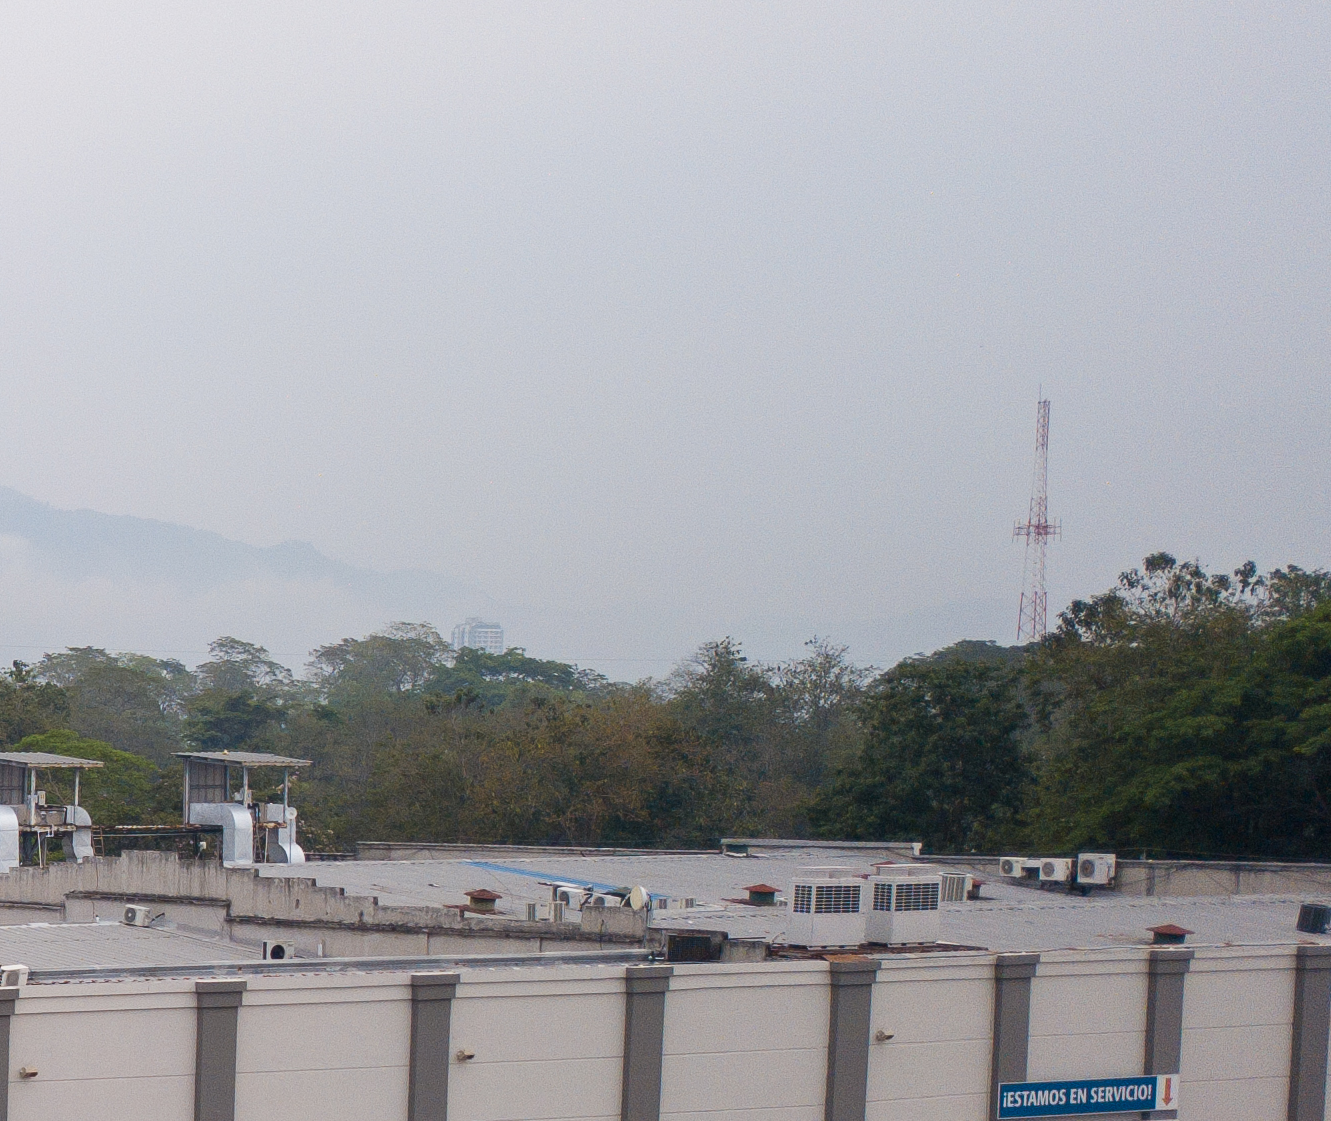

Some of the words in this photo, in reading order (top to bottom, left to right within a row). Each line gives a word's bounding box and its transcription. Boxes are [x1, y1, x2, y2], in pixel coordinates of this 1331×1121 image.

[1003, 1088, 1067, 1108] ¡ESTAMOS
[1070, 1087, 1087, 1103] EN
[1091, 1084, 1152, 1103] SERVICIO!
